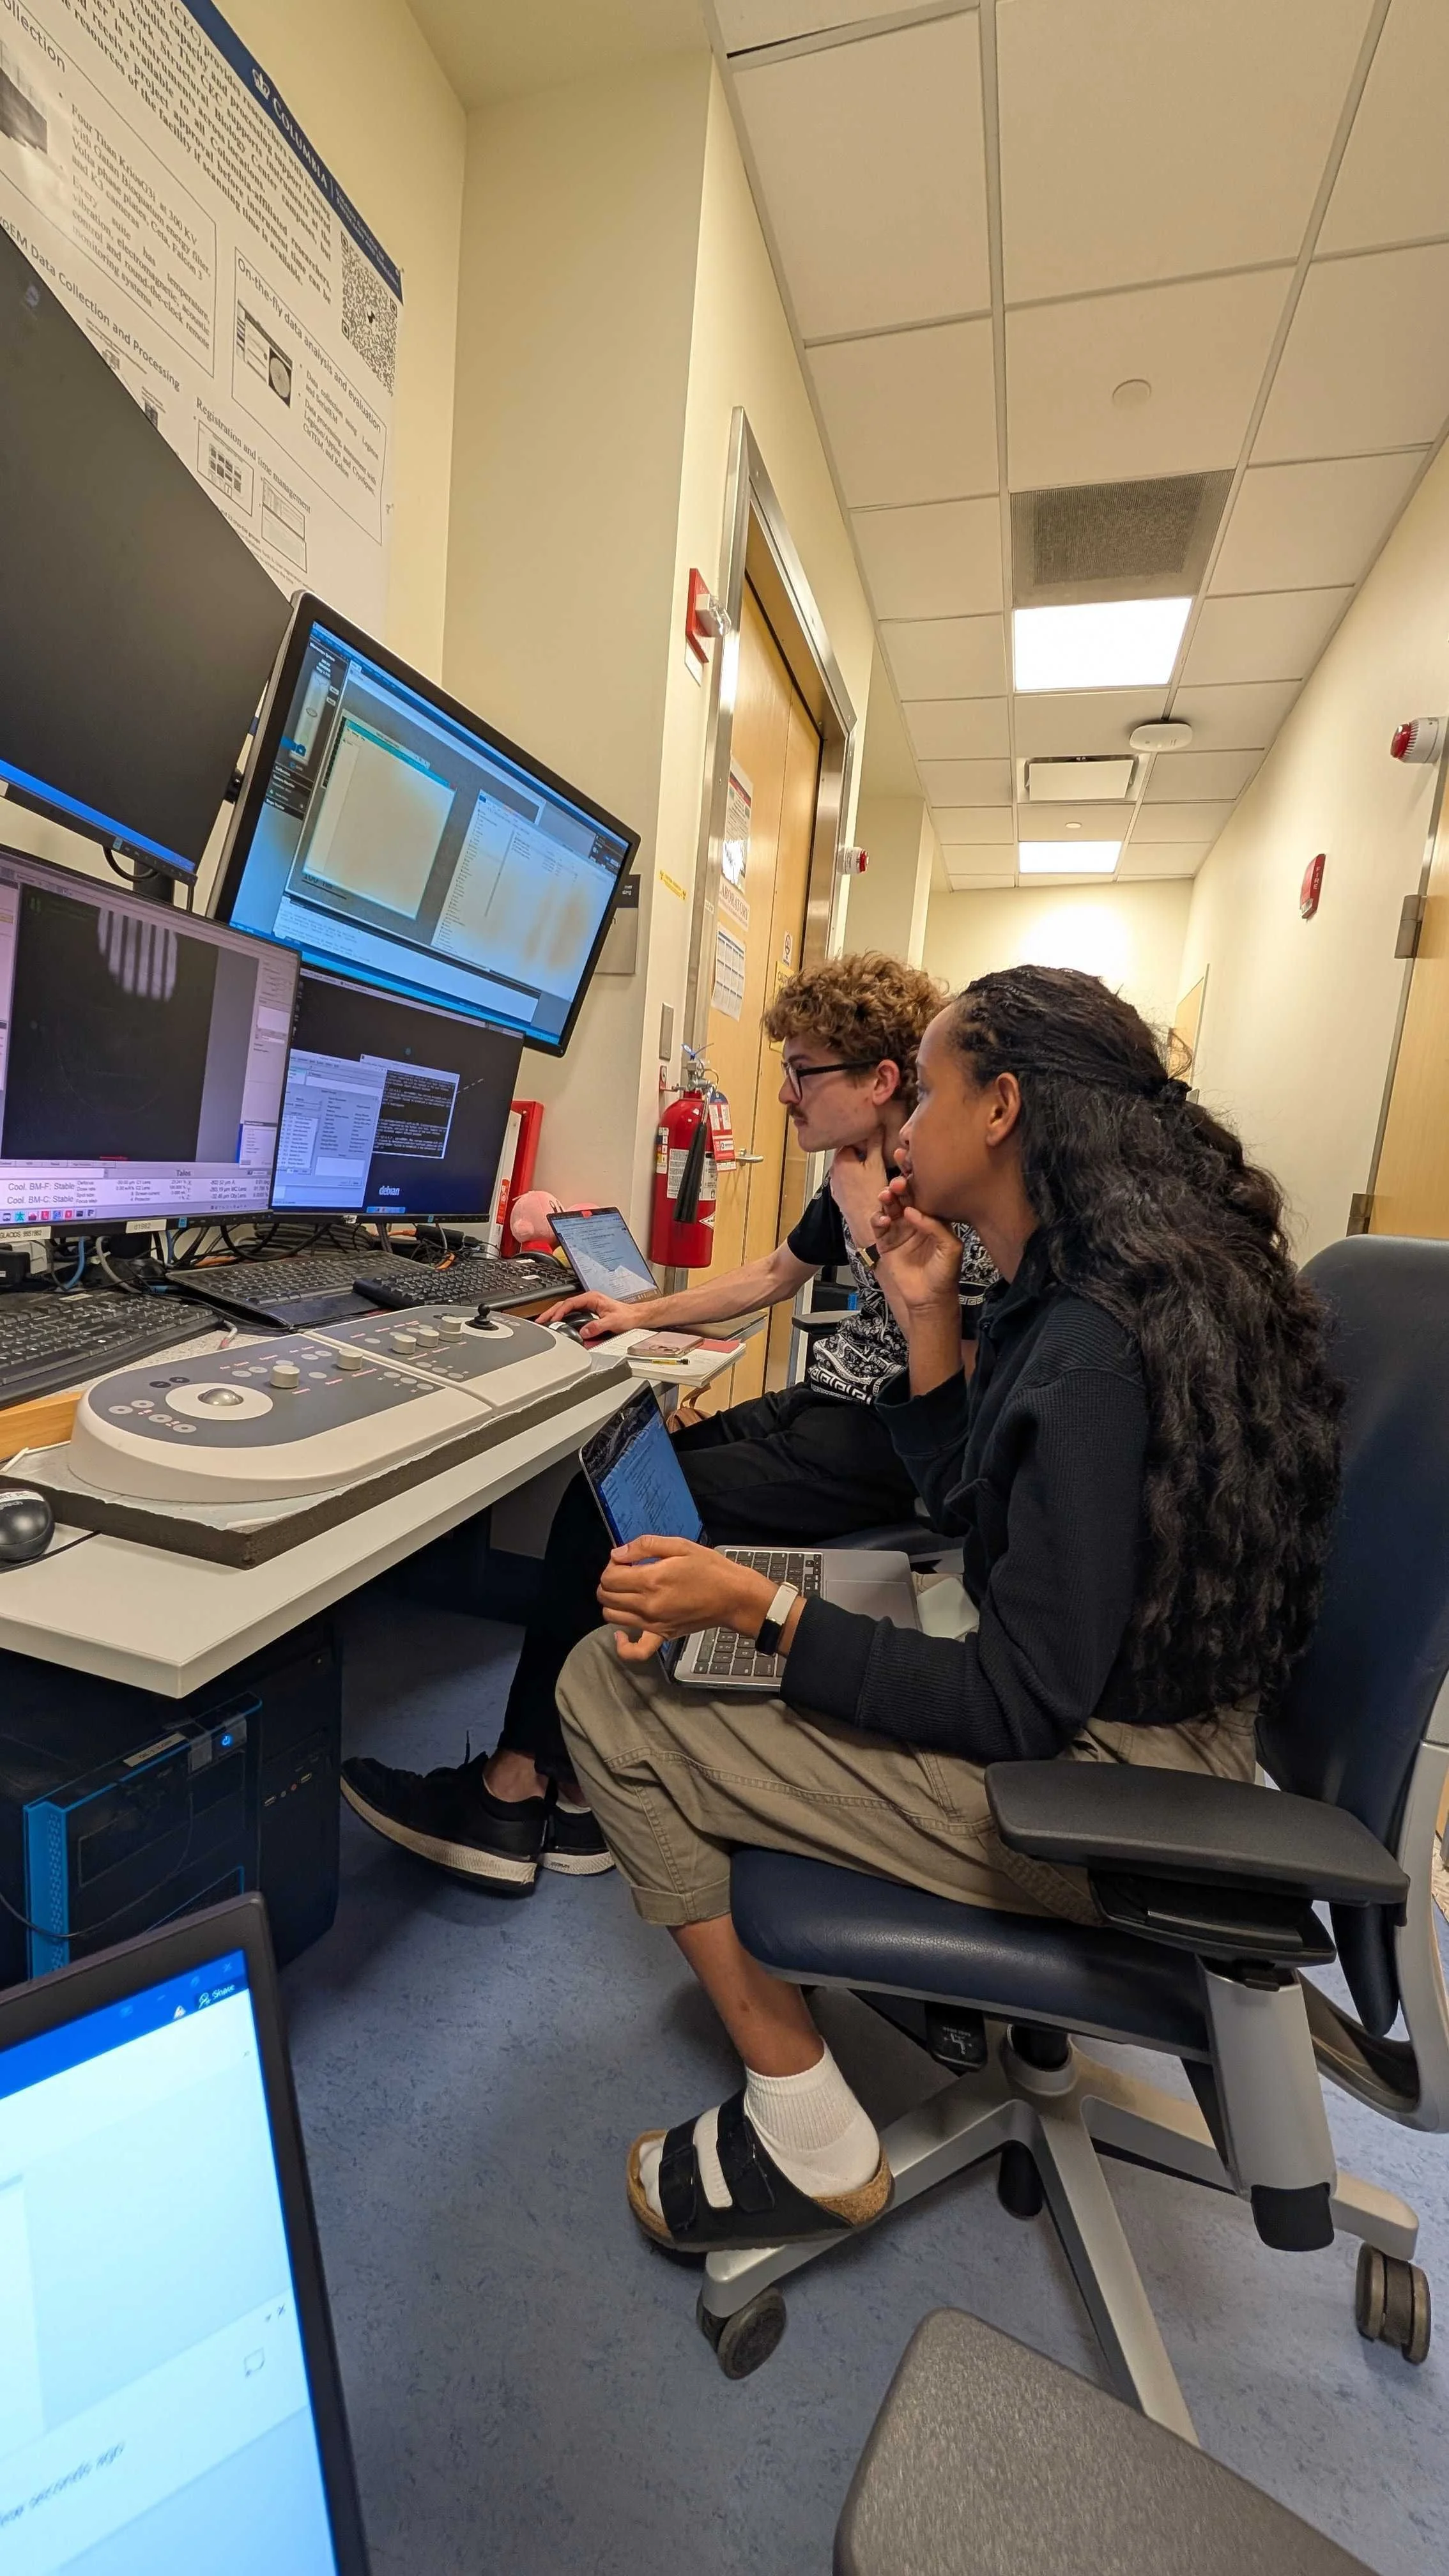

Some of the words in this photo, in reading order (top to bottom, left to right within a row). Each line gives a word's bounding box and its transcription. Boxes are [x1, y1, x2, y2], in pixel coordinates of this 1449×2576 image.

[0, 0, 65, 72] ollection
[118, 8, 135, 34] use
[138, 29, 196, 108] instruments
[198, 105, 226, 144] across
[227, 139, 265, 193] locations.
[72, 103, 93, 133] Four
[94, 128, 117, 160] Titan
[160, 202, 167, 215] at
[169, 210, 183, 231] 300
[74, 8, 125, 75] resources
[128, 74, 138, 91] of
[141, 87, 157, 112] the
[159, 108, 192, 153] facility
[194, 148, 201, 164] if
[203, 162, 240, 213] scanning
[242, 206, 260, 233] time
[261, 228, 268, 243] is
[270, 240, 303, 286] available.
[92, 11, 129, 62] receive
[134, 63, 169, 111] project
[174, 110, 213, 163] approval
[217, 160, 244, 199] before
[247, 195, 288, 252] instrument
[291, 250, 307, 275] time
[309, 274, 321, 292] can
[323, 289, 331, 305] be
[114, 18, 123, 36] is
[130, 39, 174, 98] available
[180, 98, 189, 115] to
[194, 118, 205, 135] all
[210, 136, 288, 236] Columbia-affiliated
[291, 237, 332, 293] researchers,
[130, 1, 154, 40] York
[160, 40, 209, 108] Structural
[215, 107, 246, 153] Biology
[251, 153, 278, 191] Center
[281, 194, 318, 245] campuses,
[320, 241, 331, 263] but
[169, 20, 208, 73] capacity
[211, 71, 227, 97] and
[230, 95, 272, 156] processing
[274, 152, 302, 193] support
[303, 192, 331, 234] required
[170, 1, 201, 47] (CEC)
[204, 44, 241, 96] provides
[243, 95, 287, 158] researchers
[288, 155, 303, 181] with
[305, 178, 331, 221] training
[178, 43, 196, 74] The
[201, 74, 222, 107] CEC
[227, 108, 263, 157] supports
[266, 155, 309, 217] instruments
[311, 217, 318, 230] at
[321, 229, 331, 248] the
[273, 98, 328, 188] COLUMBIA
[72, 123, 91, 148] with
[94, 145, 119, 178] Gatan
[165, 224, 190, 254] energy
[72, 155, 88, 176] and
[105, 190, 139, 229] cameras
[72, 135, 95, 167] Volta
[97, 165, 122, 195] phase
[172, 243, 196, 275] Falcon
[72, 225, 119, 277] monitoring
[73, 174, 97, 208] Every
[111, 217, 131, 241] suite
[142, 246, 156, 266] has
[167, 273, 210, 324] temperature,
[0, 216, 27, 249] oEM
[31, 243, 56, 276] Data
[59, 272, 110, 326] Collection
[112, 322, 130, 345] and
[133, 339, 180, 392] Processing
[72, 210, 103, 243] control
[106, 242, 121, 262] and
[124, 259, 183, 324] round-the-clock
[186, 321, 210, 349] remote
[117, 238, 179, 307] electromagnetic,
[181, 303, 210, 335] acoustic
[238, 257, 282, 318] On-the-fly
[284, 312, 302, 339] data
[303, 337, 333, 375] analysis
[334, 372, 347, 391] and
[348, 389, 381, 433] evaluation
[195, 396, 241, 447] Registration
[243, 443, 256, 461] and
[257, 456, 272, 476] time
[273, 471, 311, 514] management
[720, 884, 749, 921] ABORATORY
[1313, 866, 1321, 890] FIRE
[54, 1181, 75, 1190] Stable
[379, 1185, 400, 1196] debian
[212, 1984, 236, 2000] Share
